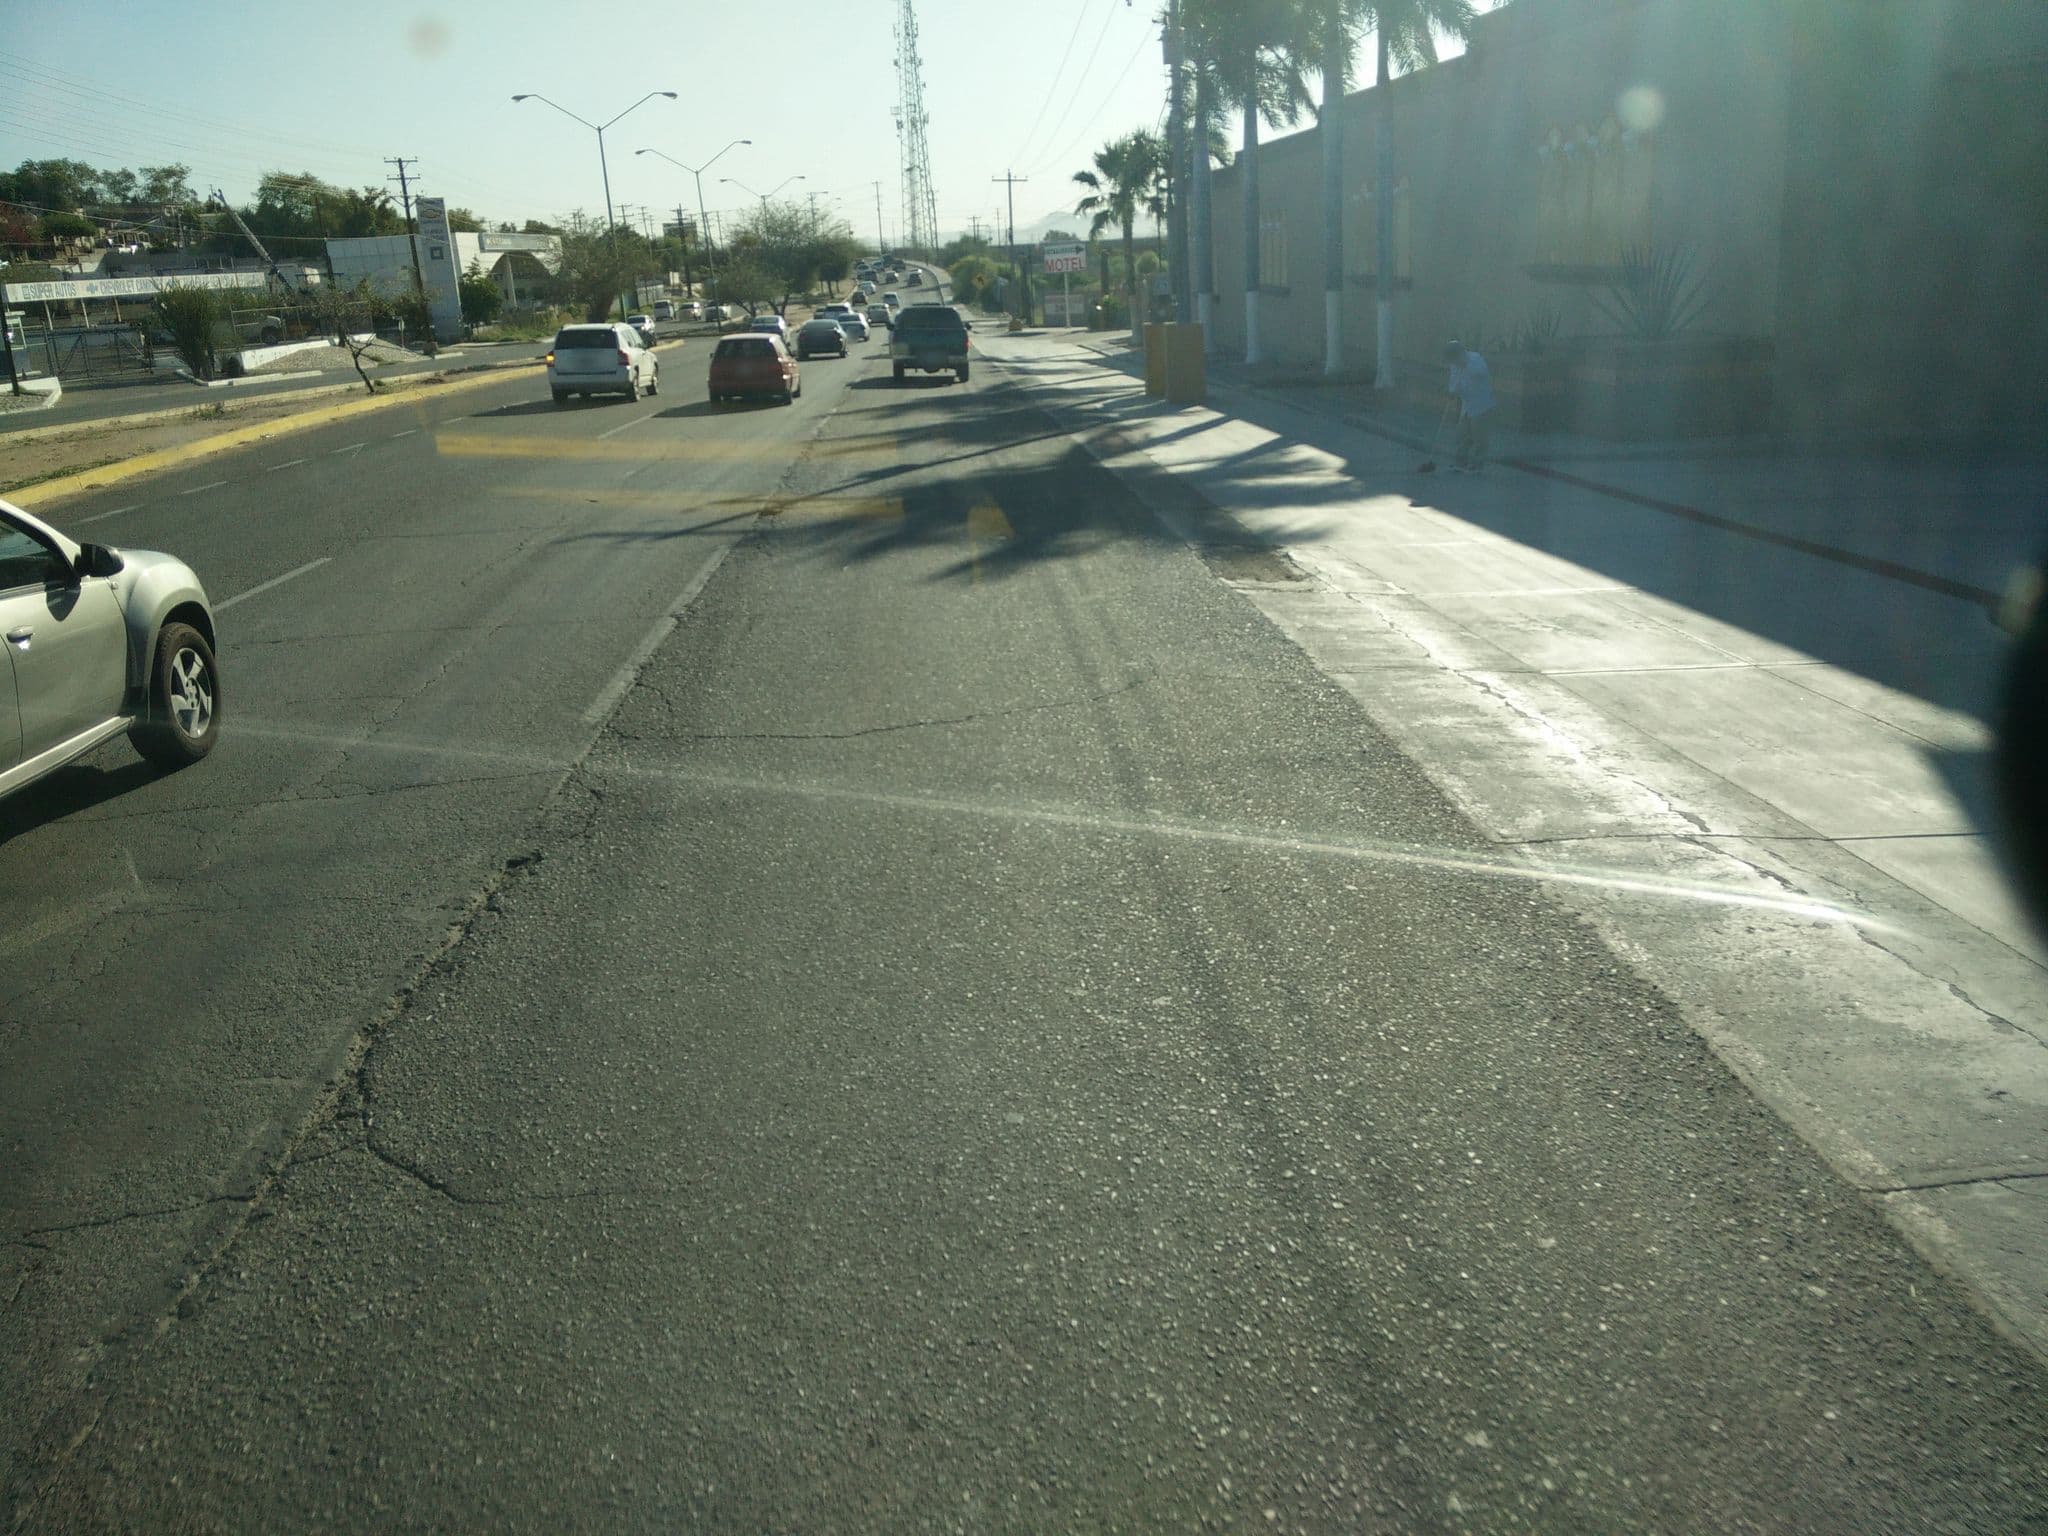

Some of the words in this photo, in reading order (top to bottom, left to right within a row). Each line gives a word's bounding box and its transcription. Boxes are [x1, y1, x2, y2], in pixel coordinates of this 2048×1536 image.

[1045, 256, 1086, 272] MOTEL
[30, 283, 54, 299] SUPER
[55, 282, 77, 298] AUTOS
[100, 280, 134, 295] CHEVROLET
